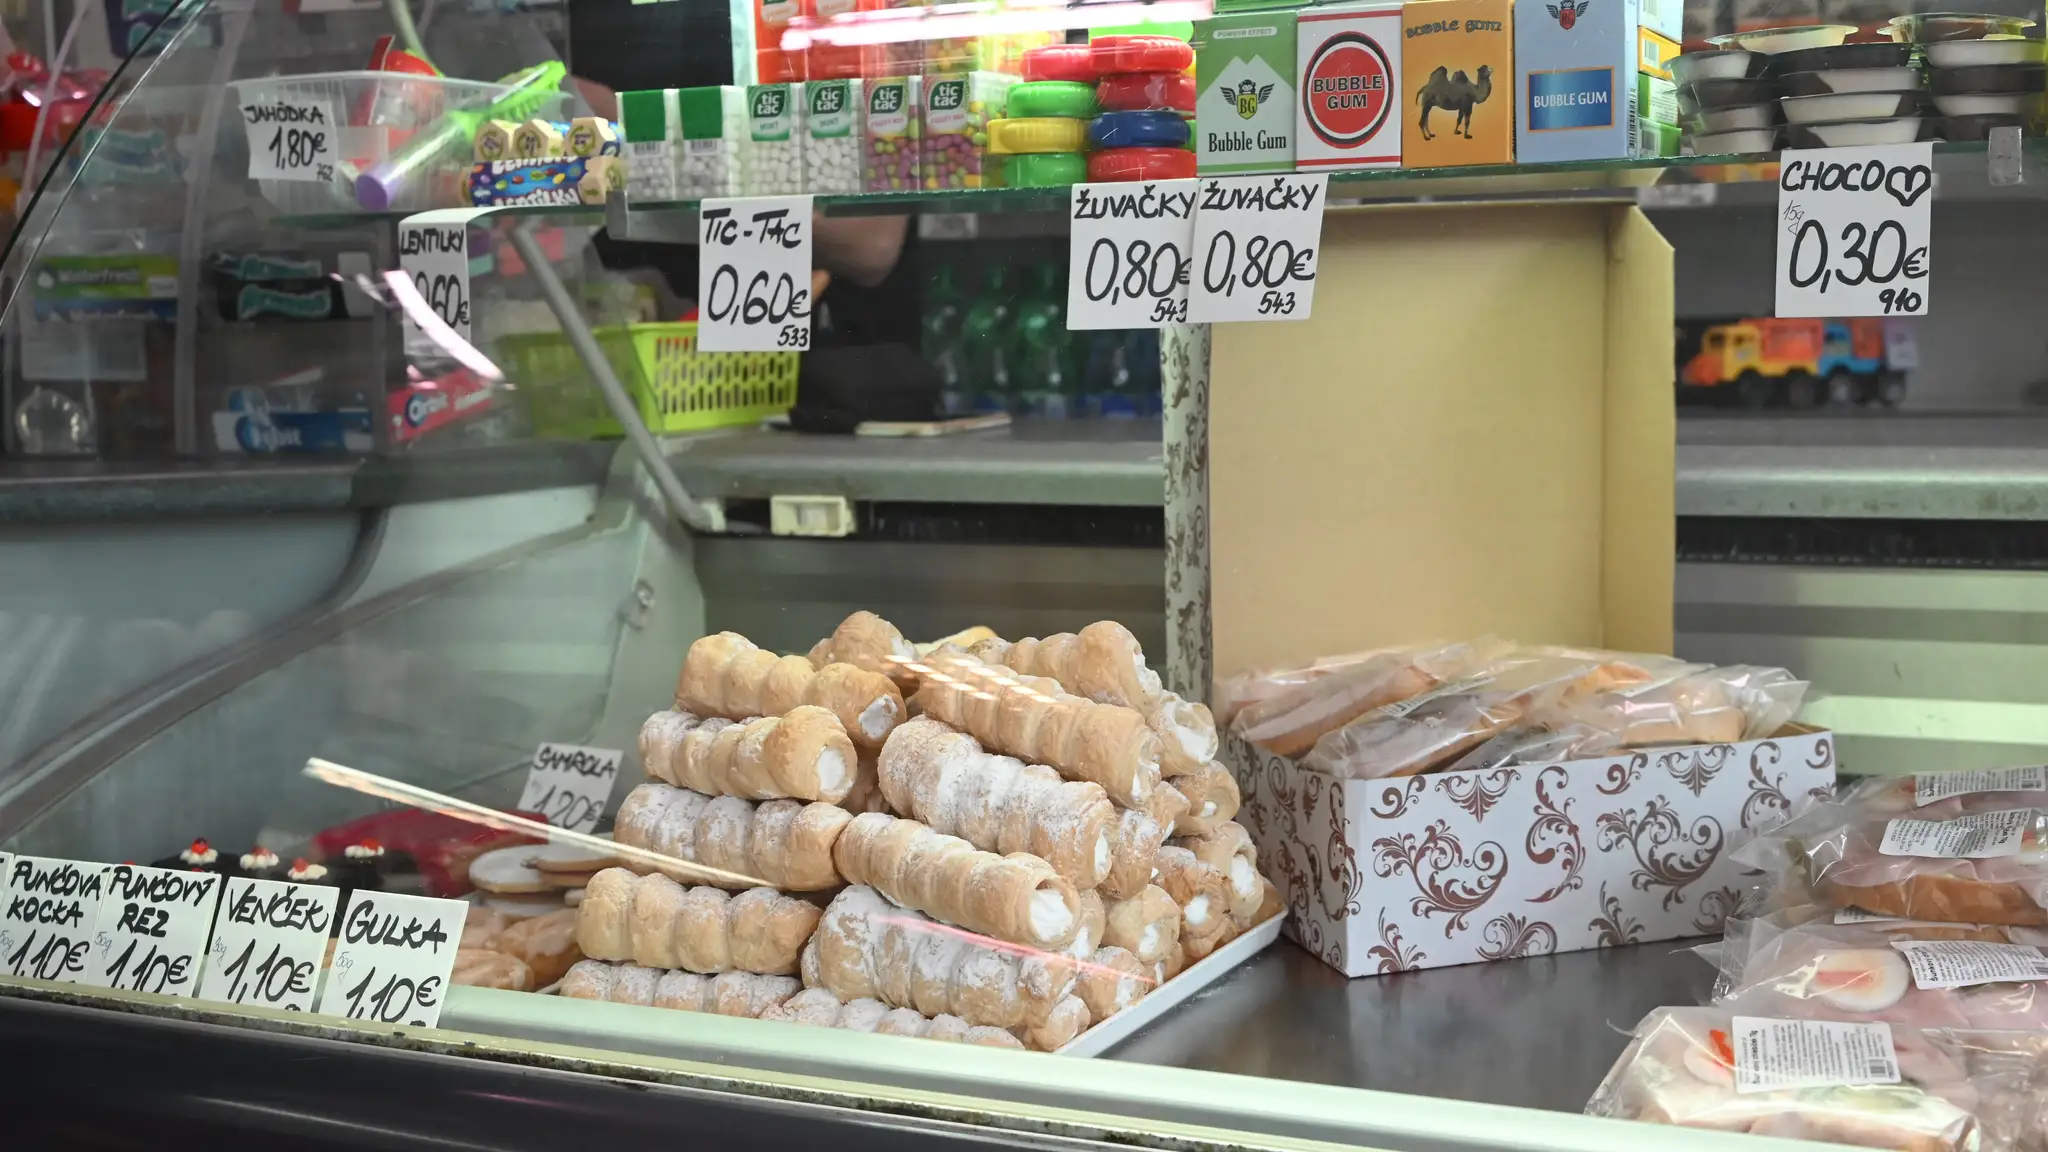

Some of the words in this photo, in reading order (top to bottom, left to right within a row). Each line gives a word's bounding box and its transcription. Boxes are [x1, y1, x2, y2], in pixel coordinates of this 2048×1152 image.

[821, 88, 840, 101] tic
[879, 88, 898, 100] tic
[938, 84, 958, 97] tic
[1313, 75, 1383, 93] BUBBLE
[757, 104, 779, 115] tac
[762, 93, 781, 105] tic
[816, 100, 839, 111] tac
[874, 99, 897, 110] tac
[934, 96, 957, 106] tac
[1240, 98, 1256, 114] BG
[1327, 94, 1368, 109] GUM
[1534, 92, 1576, 109] BUBBLE
[1578, 91, 1608, 106] GUM
[269, 126, 327, 169] 1,80€
[1208, 131, 1253, 152] Bubble
[1257, 130, 1287, 150] Gum
[1781, 160, 1885, 191] CHOCO
[1074, 184, 1196, 219] ŽUVAČKY
[1200, 177, 1319, 211] ŽUVAČKY
[1204, 230, 1316, 297] 0,80€
[1789, 219, 1929, 294] 0,30€
[1085, 238, 1192, 305] 0,80€
[708, 264, 812, 325] 0,60€
[1258, 291, 1296, 314] 543
[1879, 287, 1922, 315] 910
[1150, 298, 1188, 322] 543
[777, 325, 808, 347] 533
[10, 861, 111, 901] PUNČOVÁ
[7, 895, 84, 929] KOCKA
[229, 883, 329, 933] VENČEK
[346, 900, 448, 954] GULKA
[224, 938, 315, 1004] 1,10€
